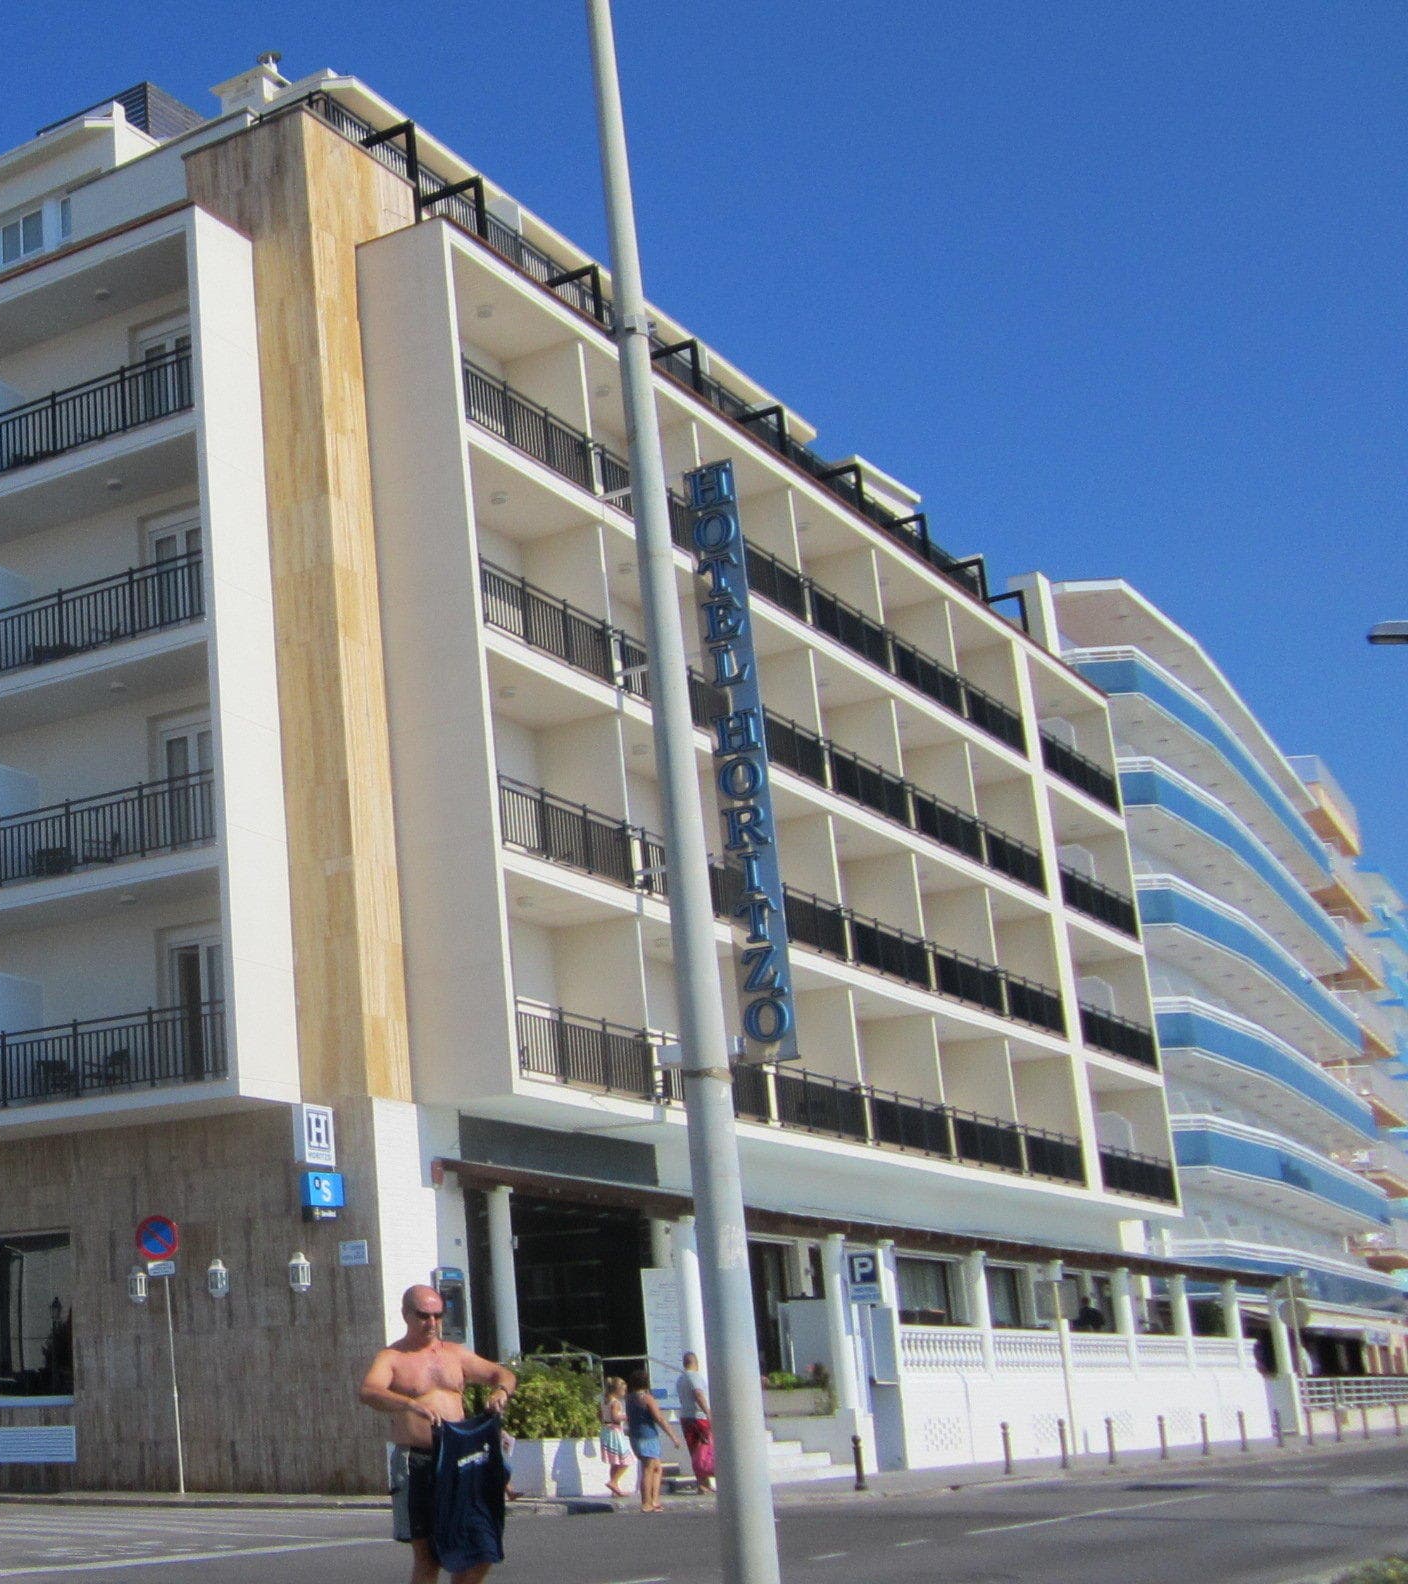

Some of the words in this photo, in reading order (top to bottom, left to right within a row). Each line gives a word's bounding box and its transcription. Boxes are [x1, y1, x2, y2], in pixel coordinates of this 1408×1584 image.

[688, 461, 750, 685] HOTEL
[308, 1112, 329, 1148] H
[854, 1257, 873, 1282] P
